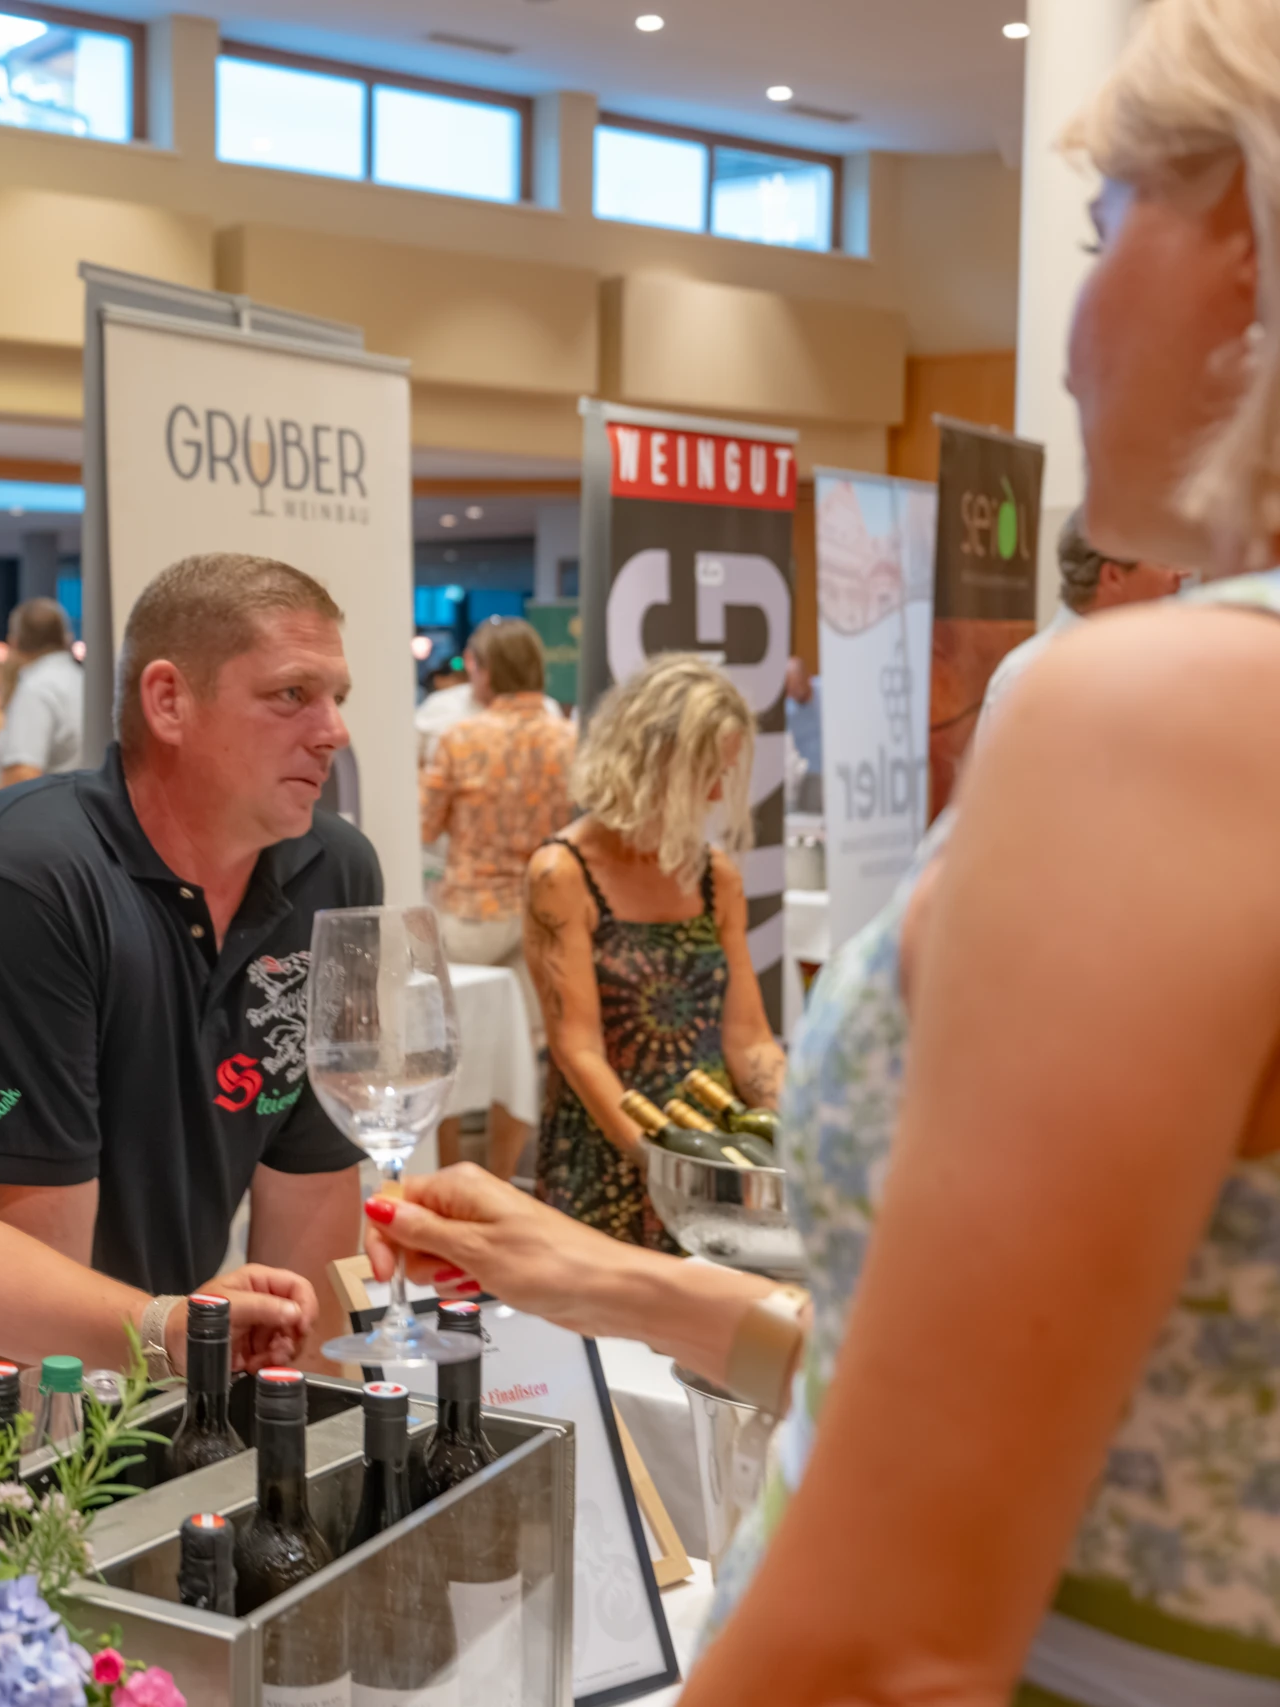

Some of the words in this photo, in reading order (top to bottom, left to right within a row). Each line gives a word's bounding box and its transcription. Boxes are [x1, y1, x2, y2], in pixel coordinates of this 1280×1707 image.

[165, 403, 367, 500] GRUBER
[615, 426, 794, 498] WEINGUT
[282, 499, 370, 526] WEINBAU
